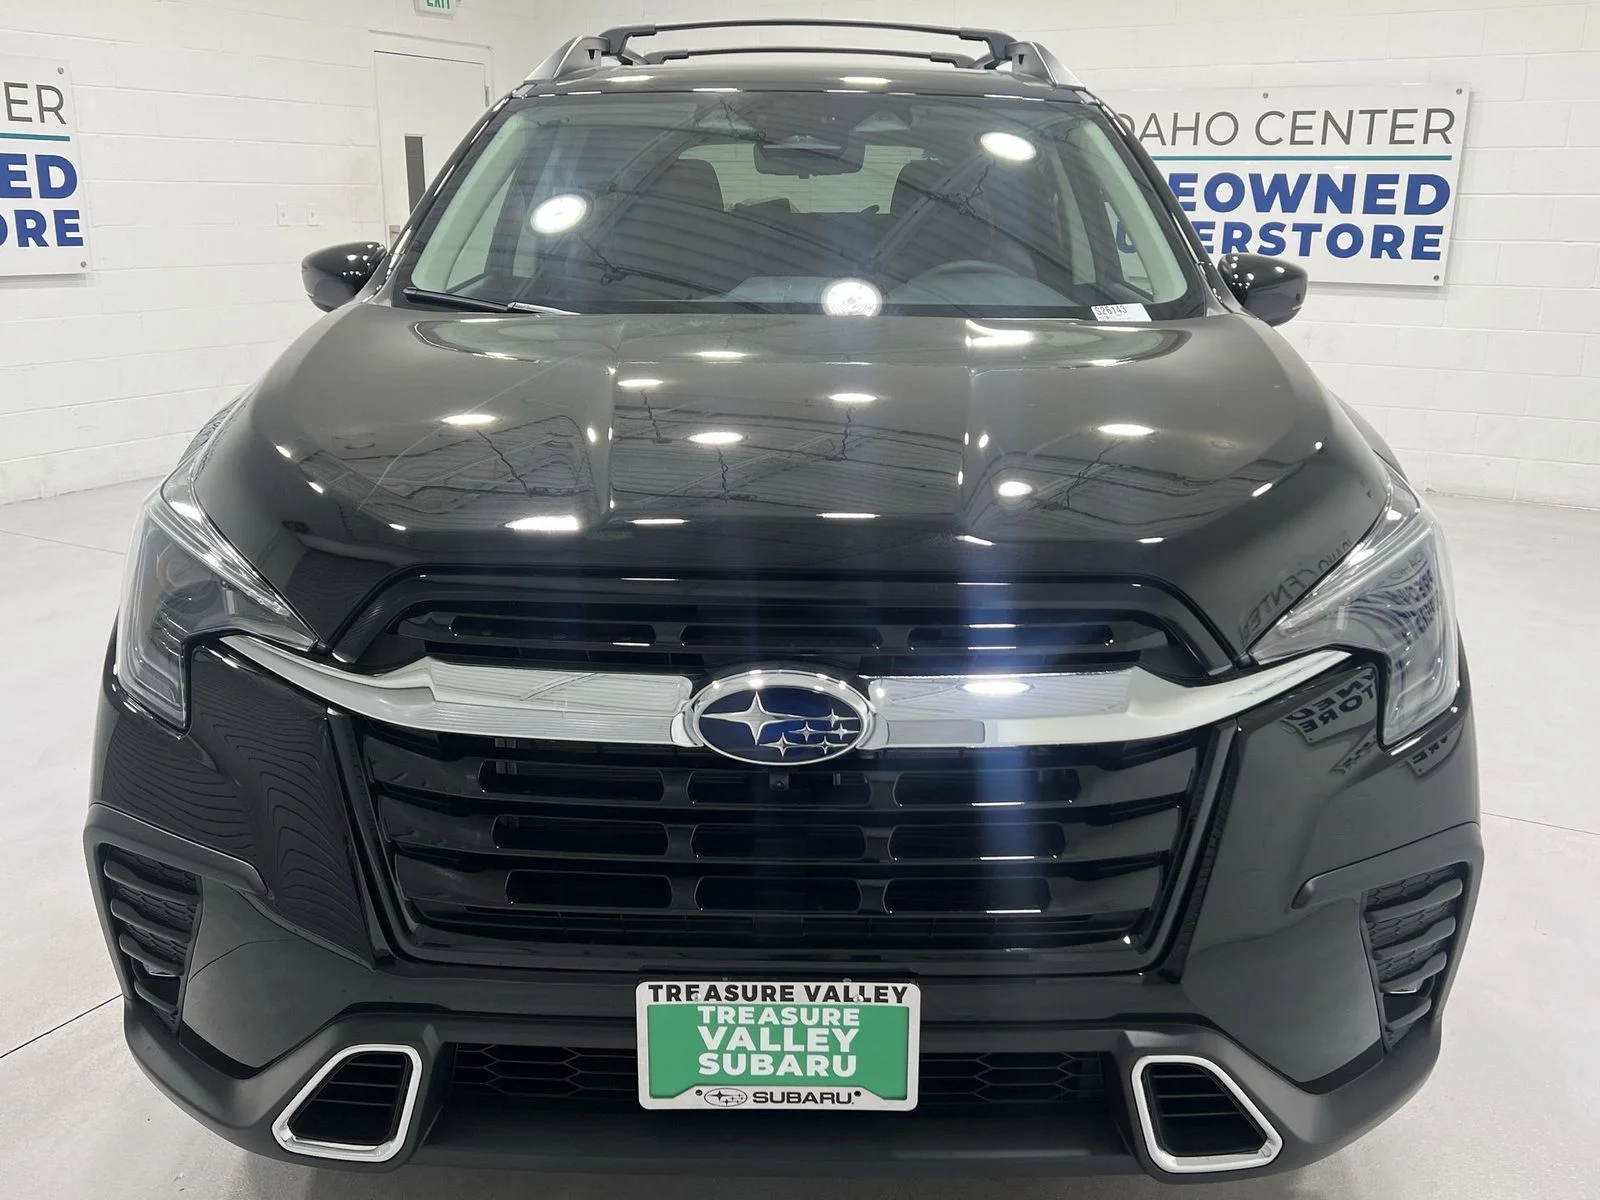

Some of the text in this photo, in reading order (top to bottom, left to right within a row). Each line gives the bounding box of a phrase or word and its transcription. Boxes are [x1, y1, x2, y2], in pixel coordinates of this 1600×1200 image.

[1254, 108, 1455, 146] CENTER
[0, 209, 84, 248] RE
[1094, 305, 1128, 316] S26143
[648, 983, 908, 1005] TREASURE VALLEY
[697, 1005, 860, 1027] TREASURE
[697, 1025, 860, 1053] VALLEY
[698, 1052, 857, 1078] SUBARU
